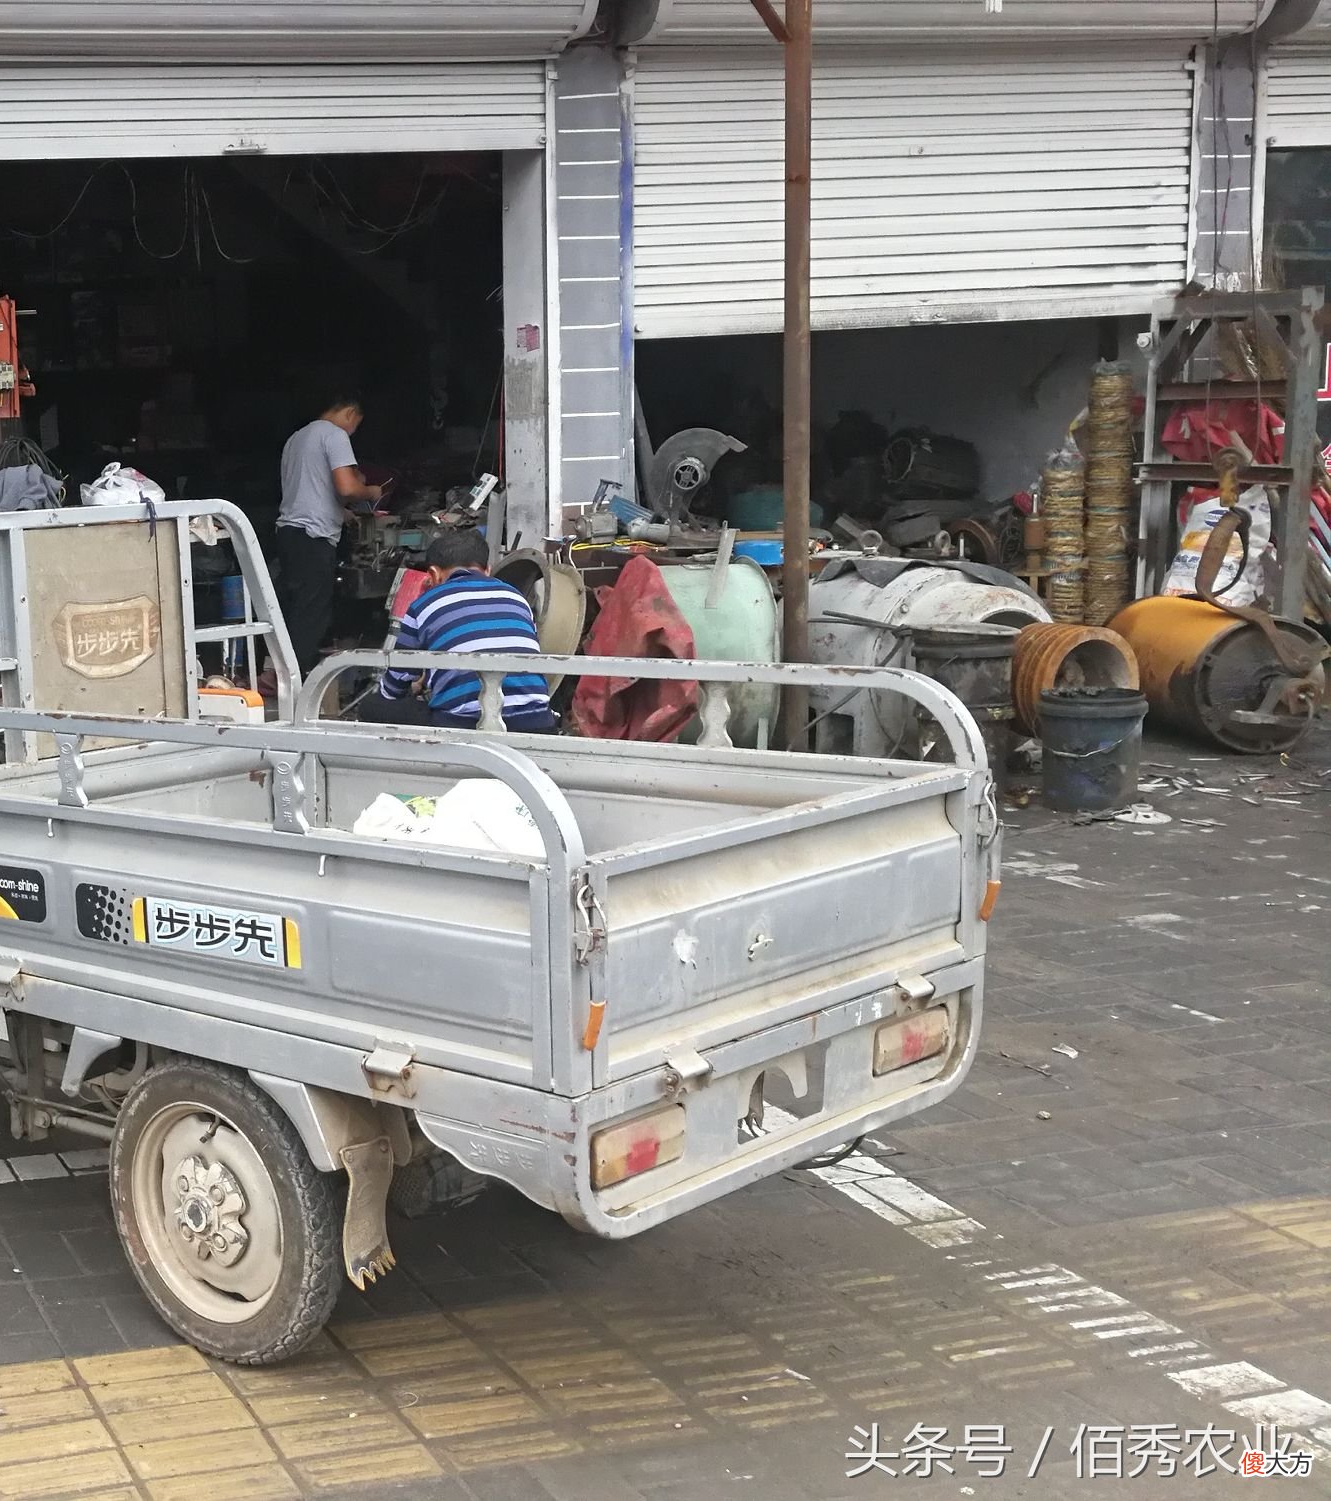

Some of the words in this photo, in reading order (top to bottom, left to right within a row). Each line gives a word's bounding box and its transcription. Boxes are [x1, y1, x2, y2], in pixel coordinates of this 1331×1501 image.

[76, 628, 141, 658] 步步先
[154, 905, 277, 960] 步步先
